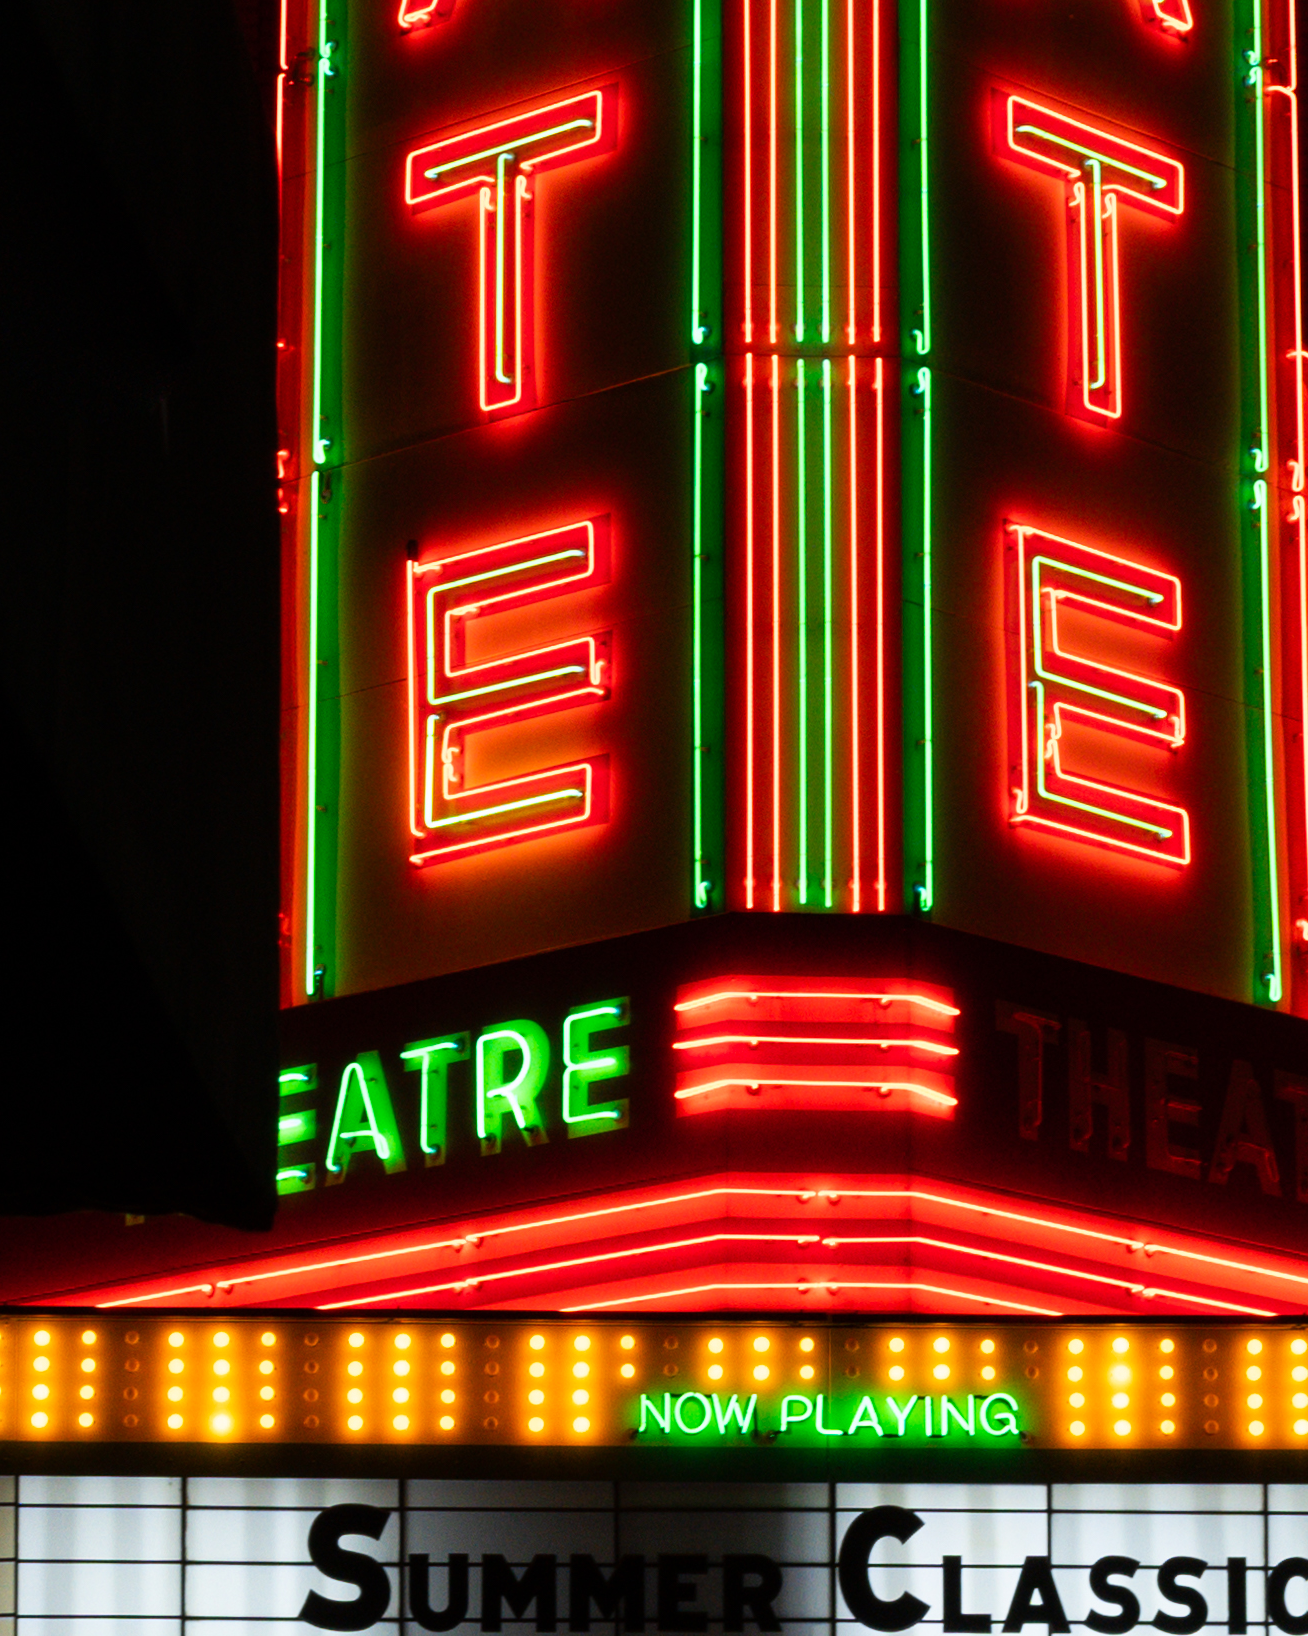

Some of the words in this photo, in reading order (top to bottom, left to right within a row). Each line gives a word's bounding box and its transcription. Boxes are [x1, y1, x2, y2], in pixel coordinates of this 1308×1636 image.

[276, 995, 632, 1196] EATRE
[638, 1392, 758, 1435] NOW
[779, 1392, 1021, 1437] PLAYING
